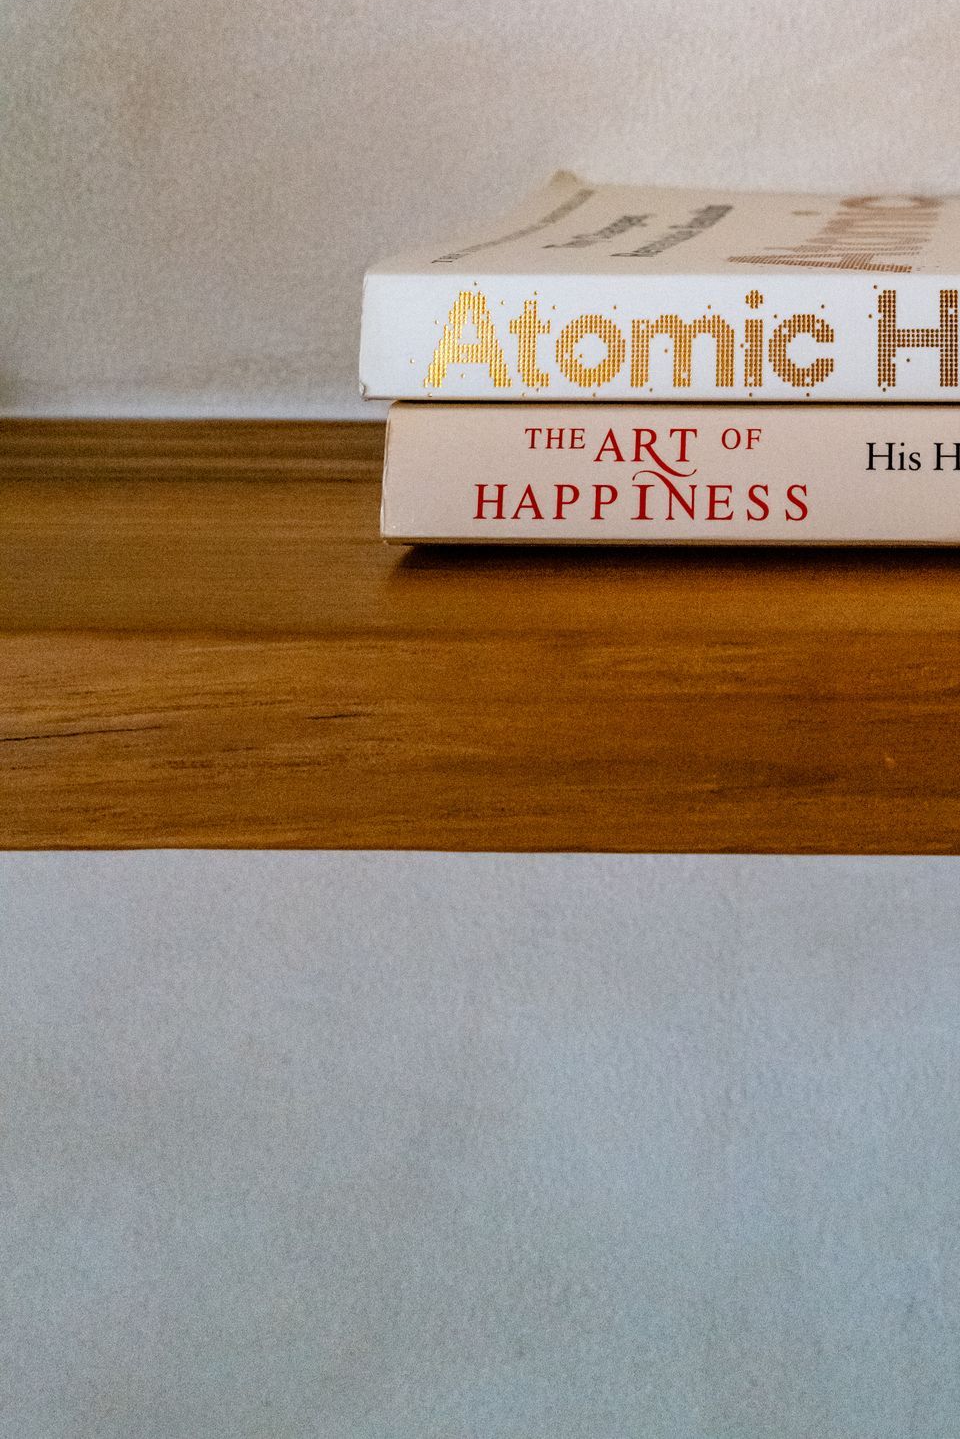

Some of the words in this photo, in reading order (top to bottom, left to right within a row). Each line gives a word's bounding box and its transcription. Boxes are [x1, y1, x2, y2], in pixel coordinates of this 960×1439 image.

[423, 289, 835, 389] Atomic
[525, 427, 585, 450] THE
[594, 427, 698, 479] ART
[721, 428, 762, 450] OF
[865, 442, 922, 472] His
[473, 470, 809, 522] HAPPINESS
